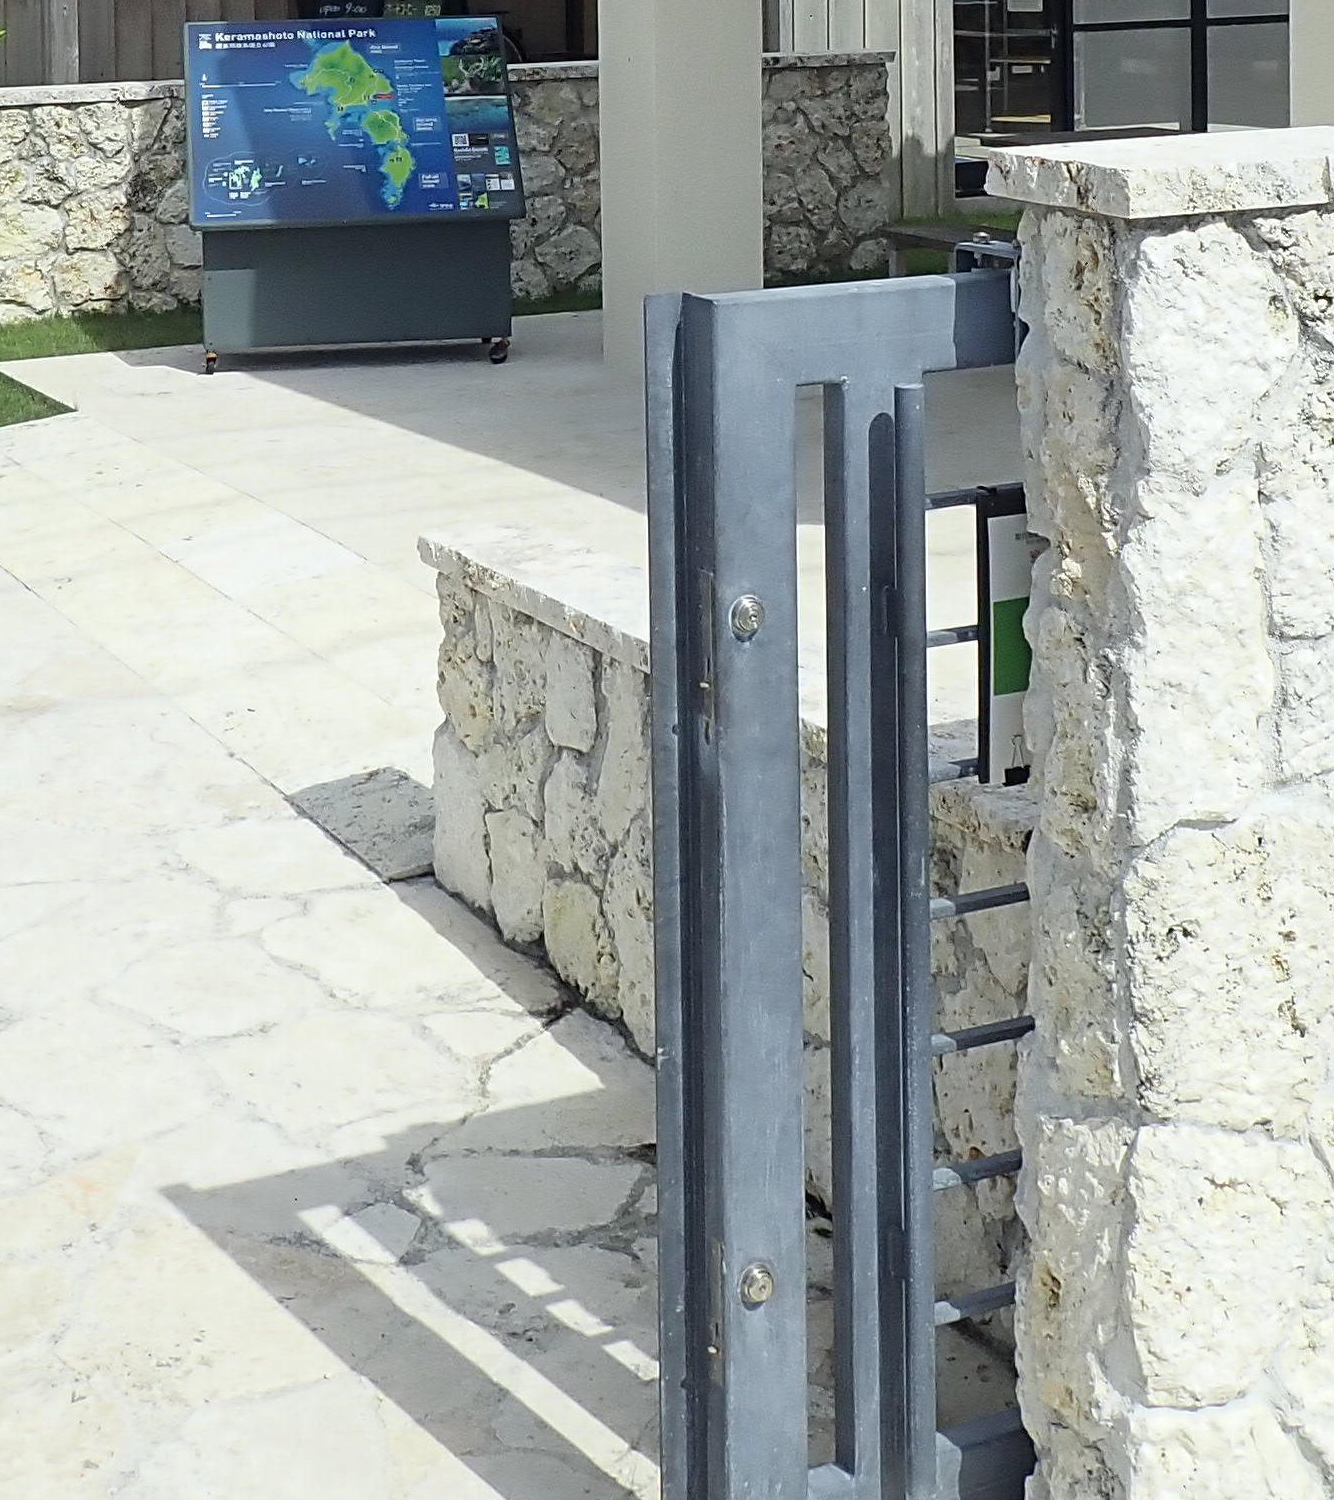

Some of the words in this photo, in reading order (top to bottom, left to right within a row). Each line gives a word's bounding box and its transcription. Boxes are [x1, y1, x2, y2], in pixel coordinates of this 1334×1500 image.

[215, 32, 295, 42] Keramashoto
[297, 29, 346, 40] National
[348, 28, 376, 39] Park
